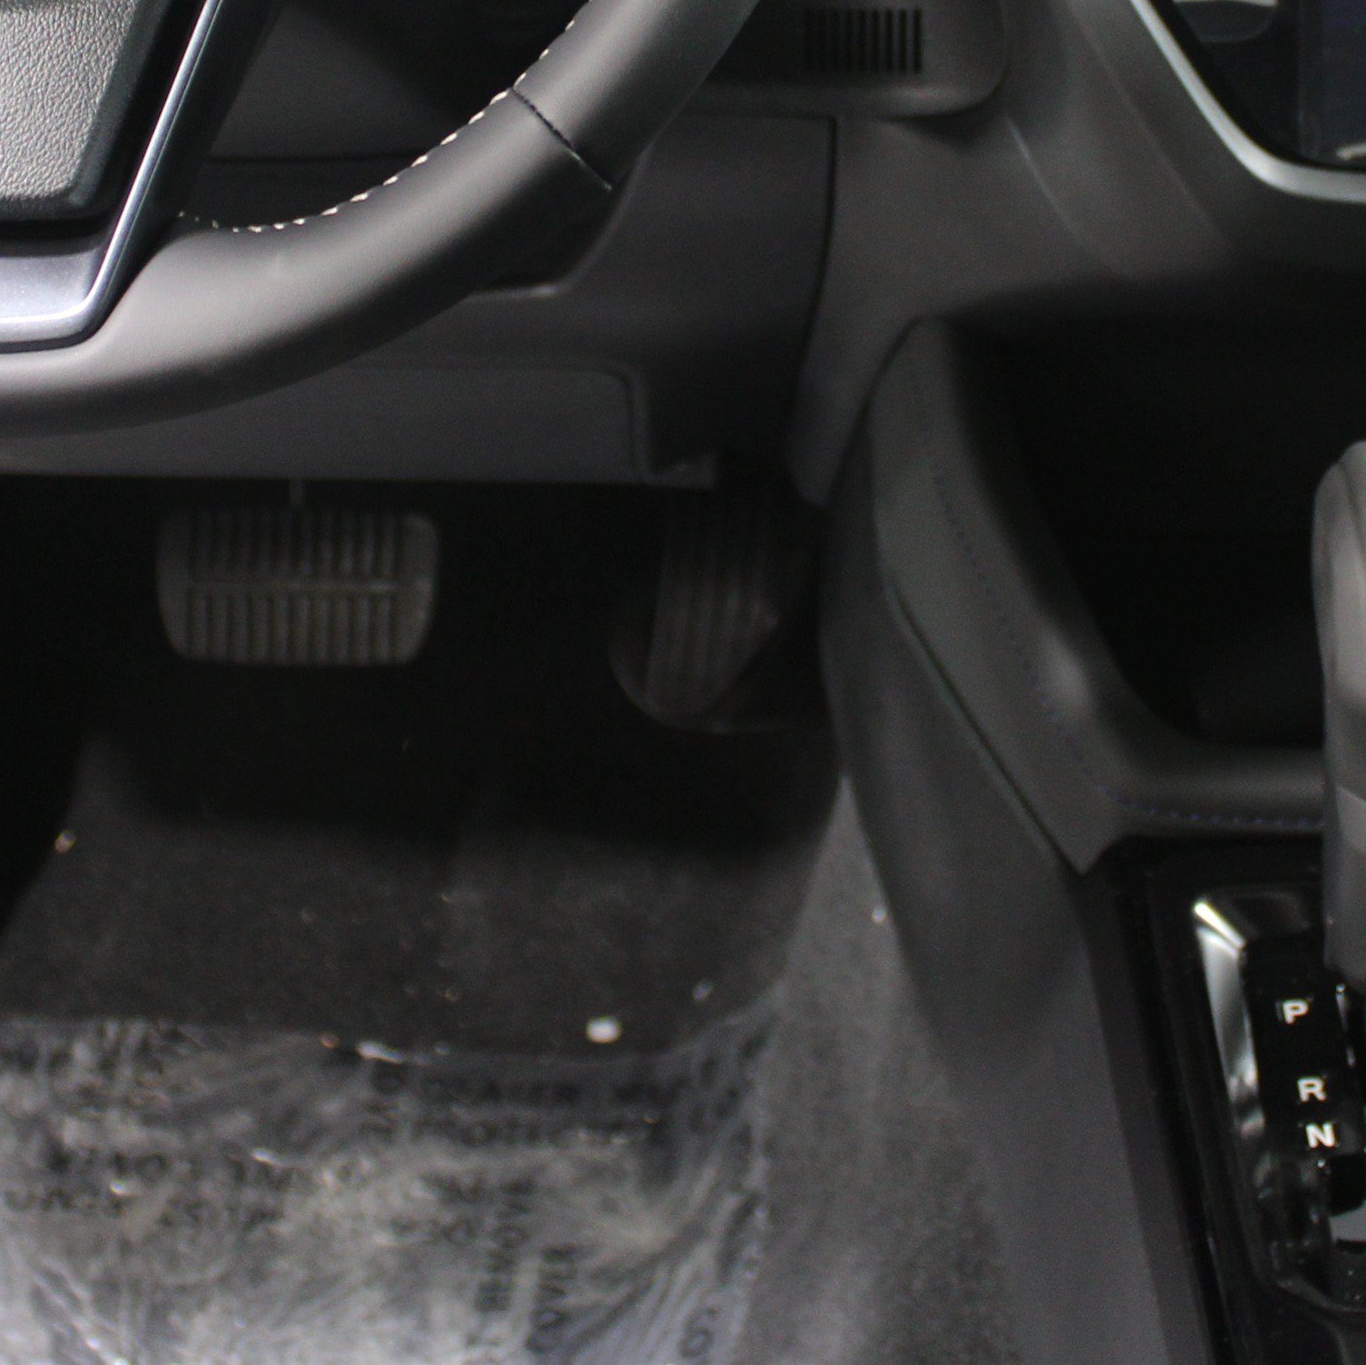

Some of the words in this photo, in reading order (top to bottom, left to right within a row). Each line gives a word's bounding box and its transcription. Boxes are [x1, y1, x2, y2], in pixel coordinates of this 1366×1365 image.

[1283, 999, 1309, 1024] P
[1297, 1076, 1327, 1102] R
[1306, 1123, 1335, 1148] N
